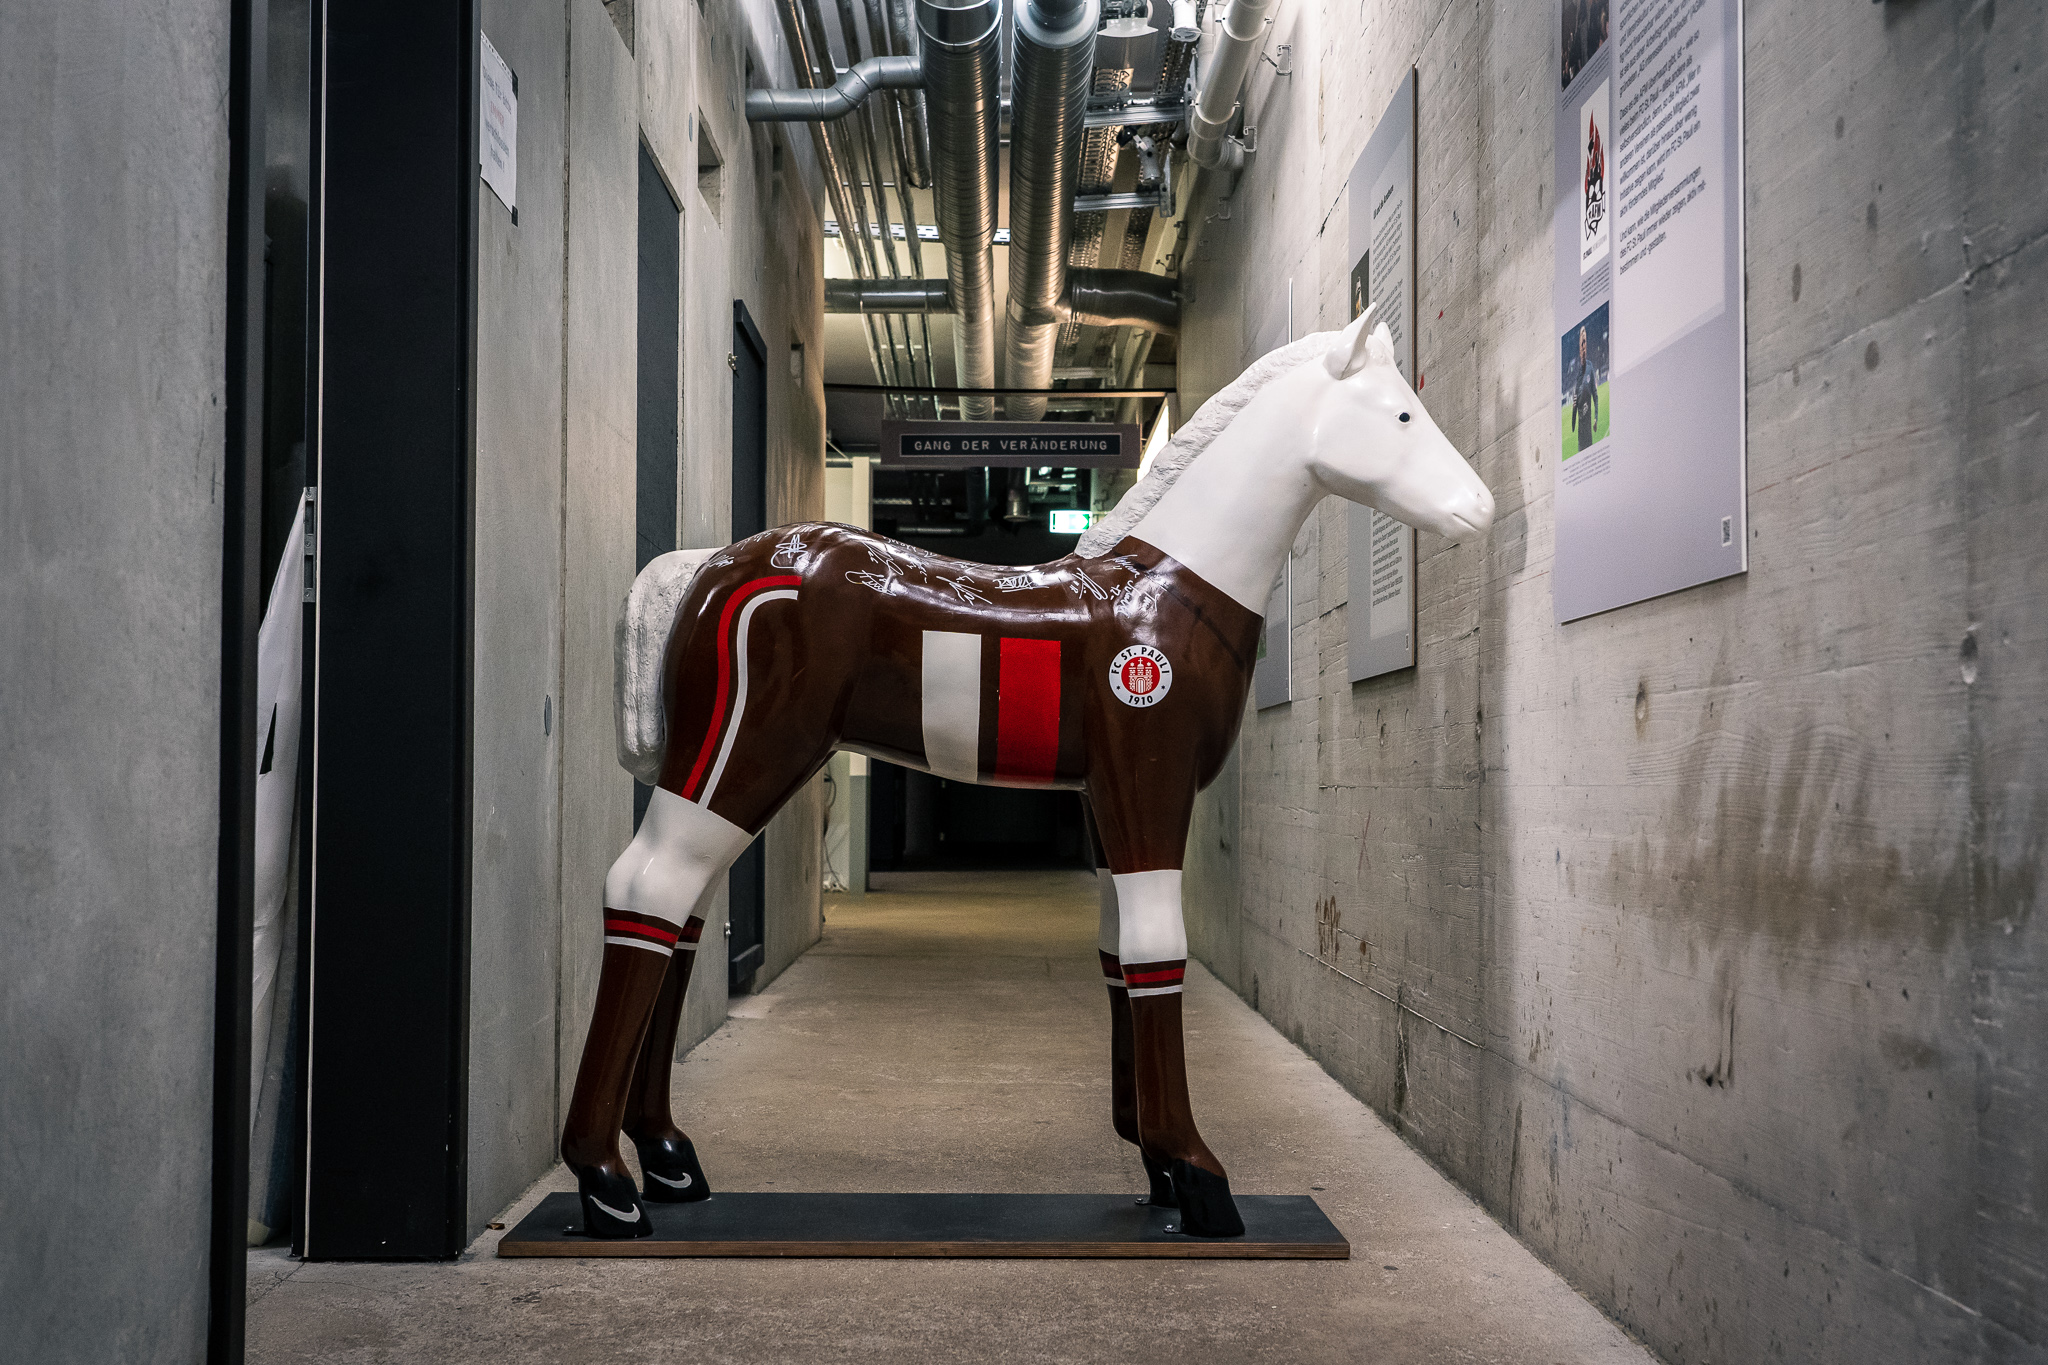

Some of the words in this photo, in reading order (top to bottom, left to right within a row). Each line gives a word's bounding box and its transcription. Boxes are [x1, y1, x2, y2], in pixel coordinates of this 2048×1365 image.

[914, 441, 952, 451] GANG
[961, 440, 990, 451] DER
[1000, 437, 1108, 451] VERÄNDERUNG
[1111, 662, 1122, 675] FC
[1121, 648, 1137, 661] ST.
[1141, 646, 1170, 674] PAULI
[1128, 695, 1153, 705] 1910
